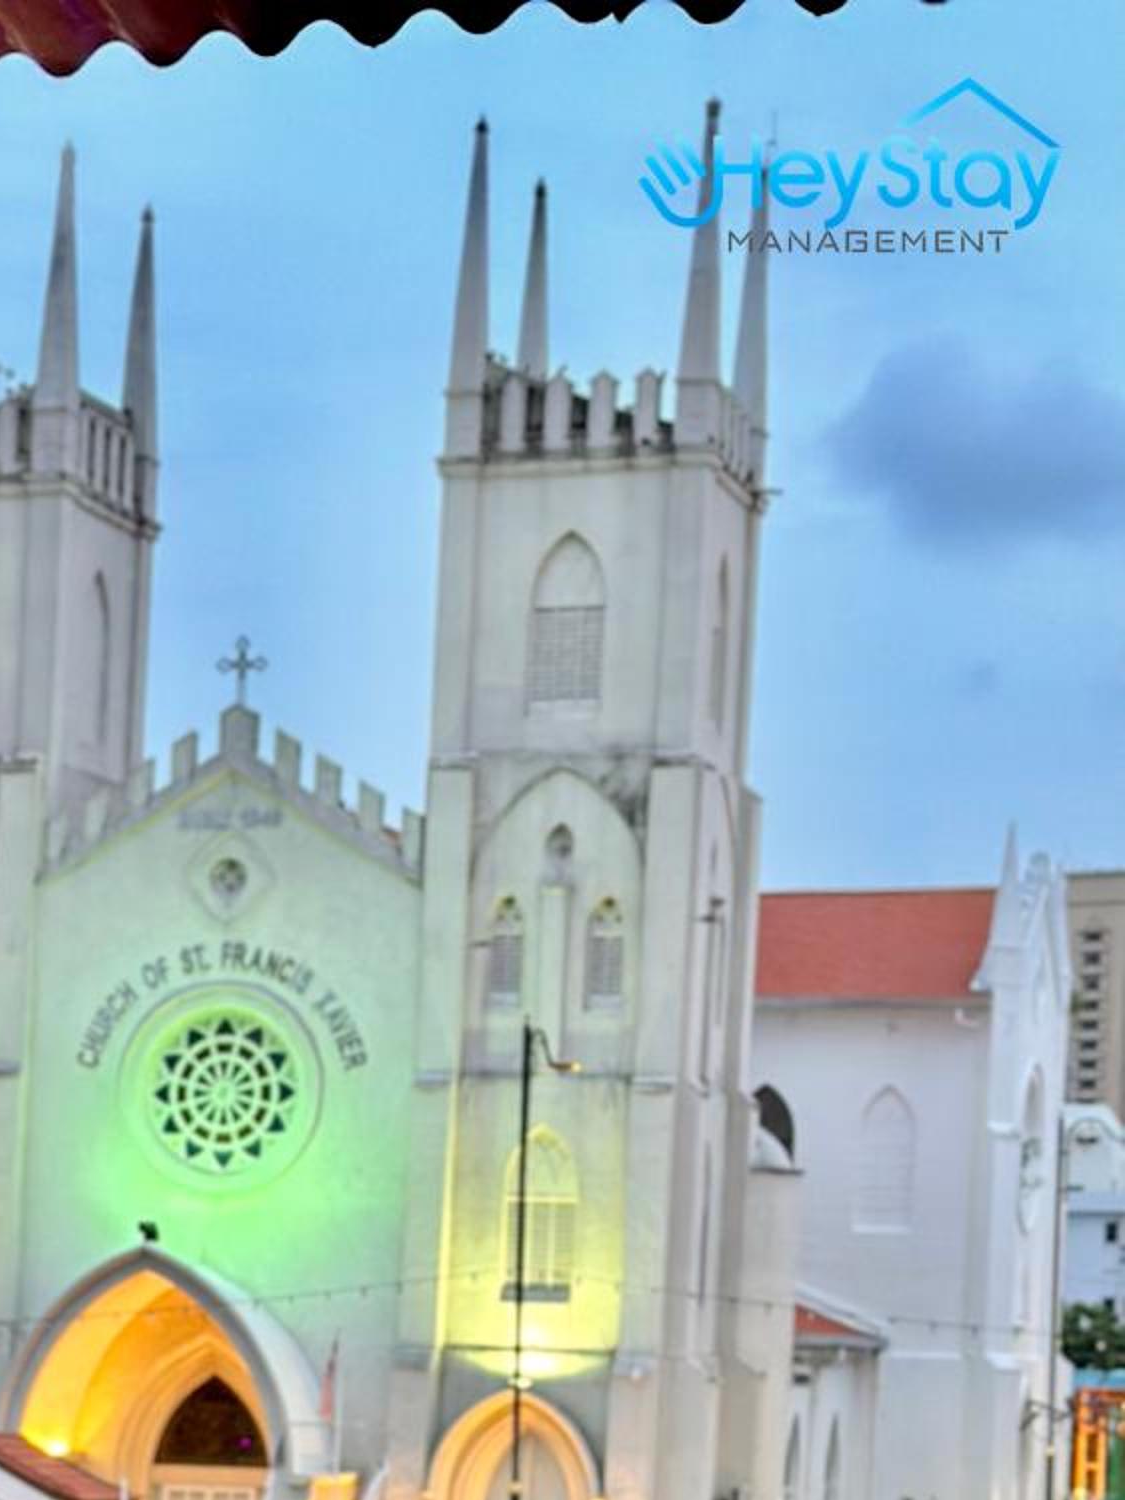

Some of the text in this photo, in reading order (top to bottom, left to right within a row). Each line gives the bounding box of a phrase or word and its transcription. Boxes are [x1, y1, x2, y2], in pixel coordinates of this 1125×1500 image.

[78, 941, 368, 1071] CHURCH OF ST. FRANCIS XAVIER
